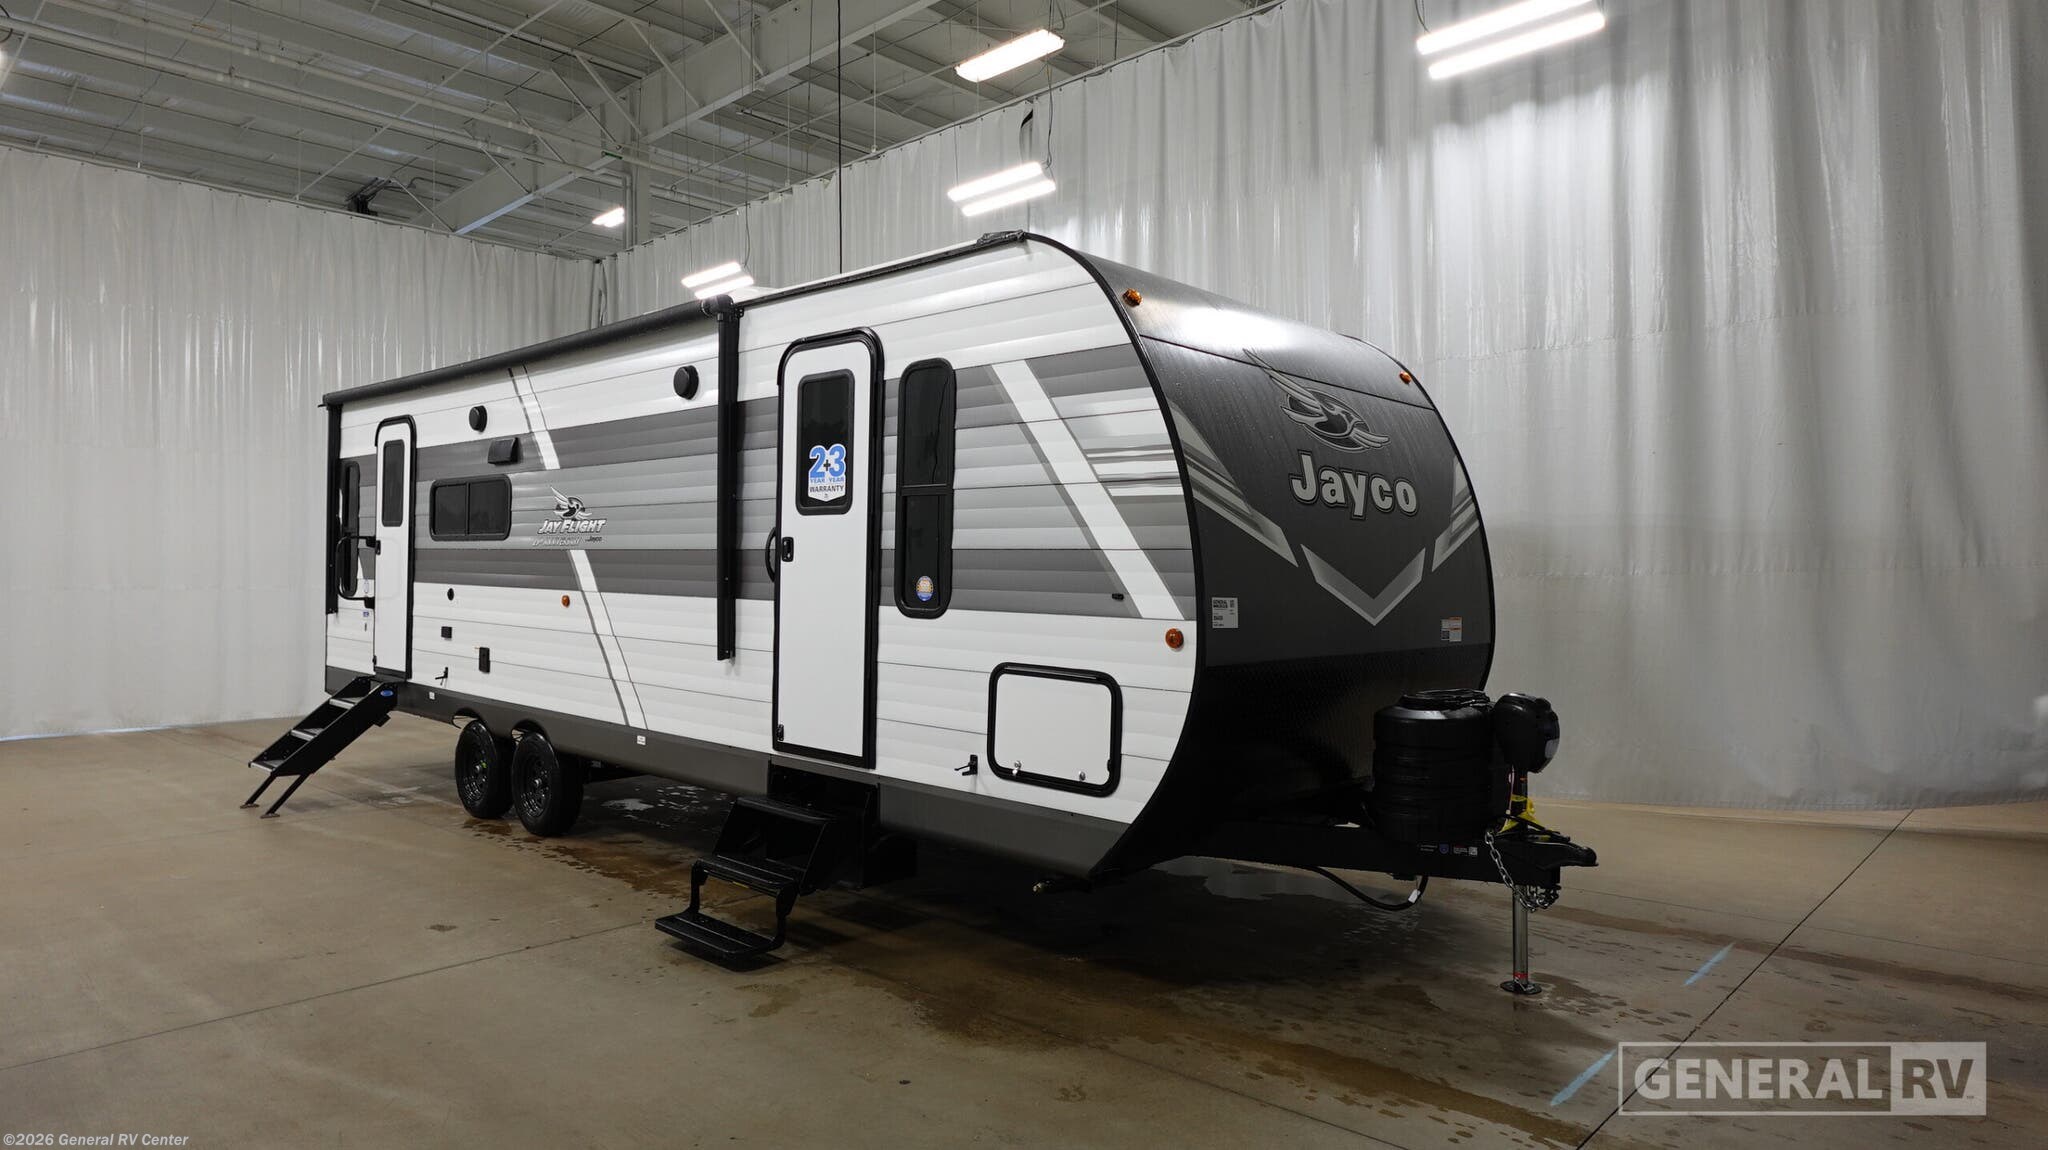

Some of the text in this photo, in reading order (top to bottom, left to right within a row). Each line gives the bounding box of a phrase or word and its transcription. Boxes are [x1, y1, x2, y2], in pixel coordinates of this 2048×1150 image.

[809, 485, 845, 493] WARRANTY
[1290, 451, 1418, 519] Jayco
[538, 518, 607, 534] JAY FLIGHT
